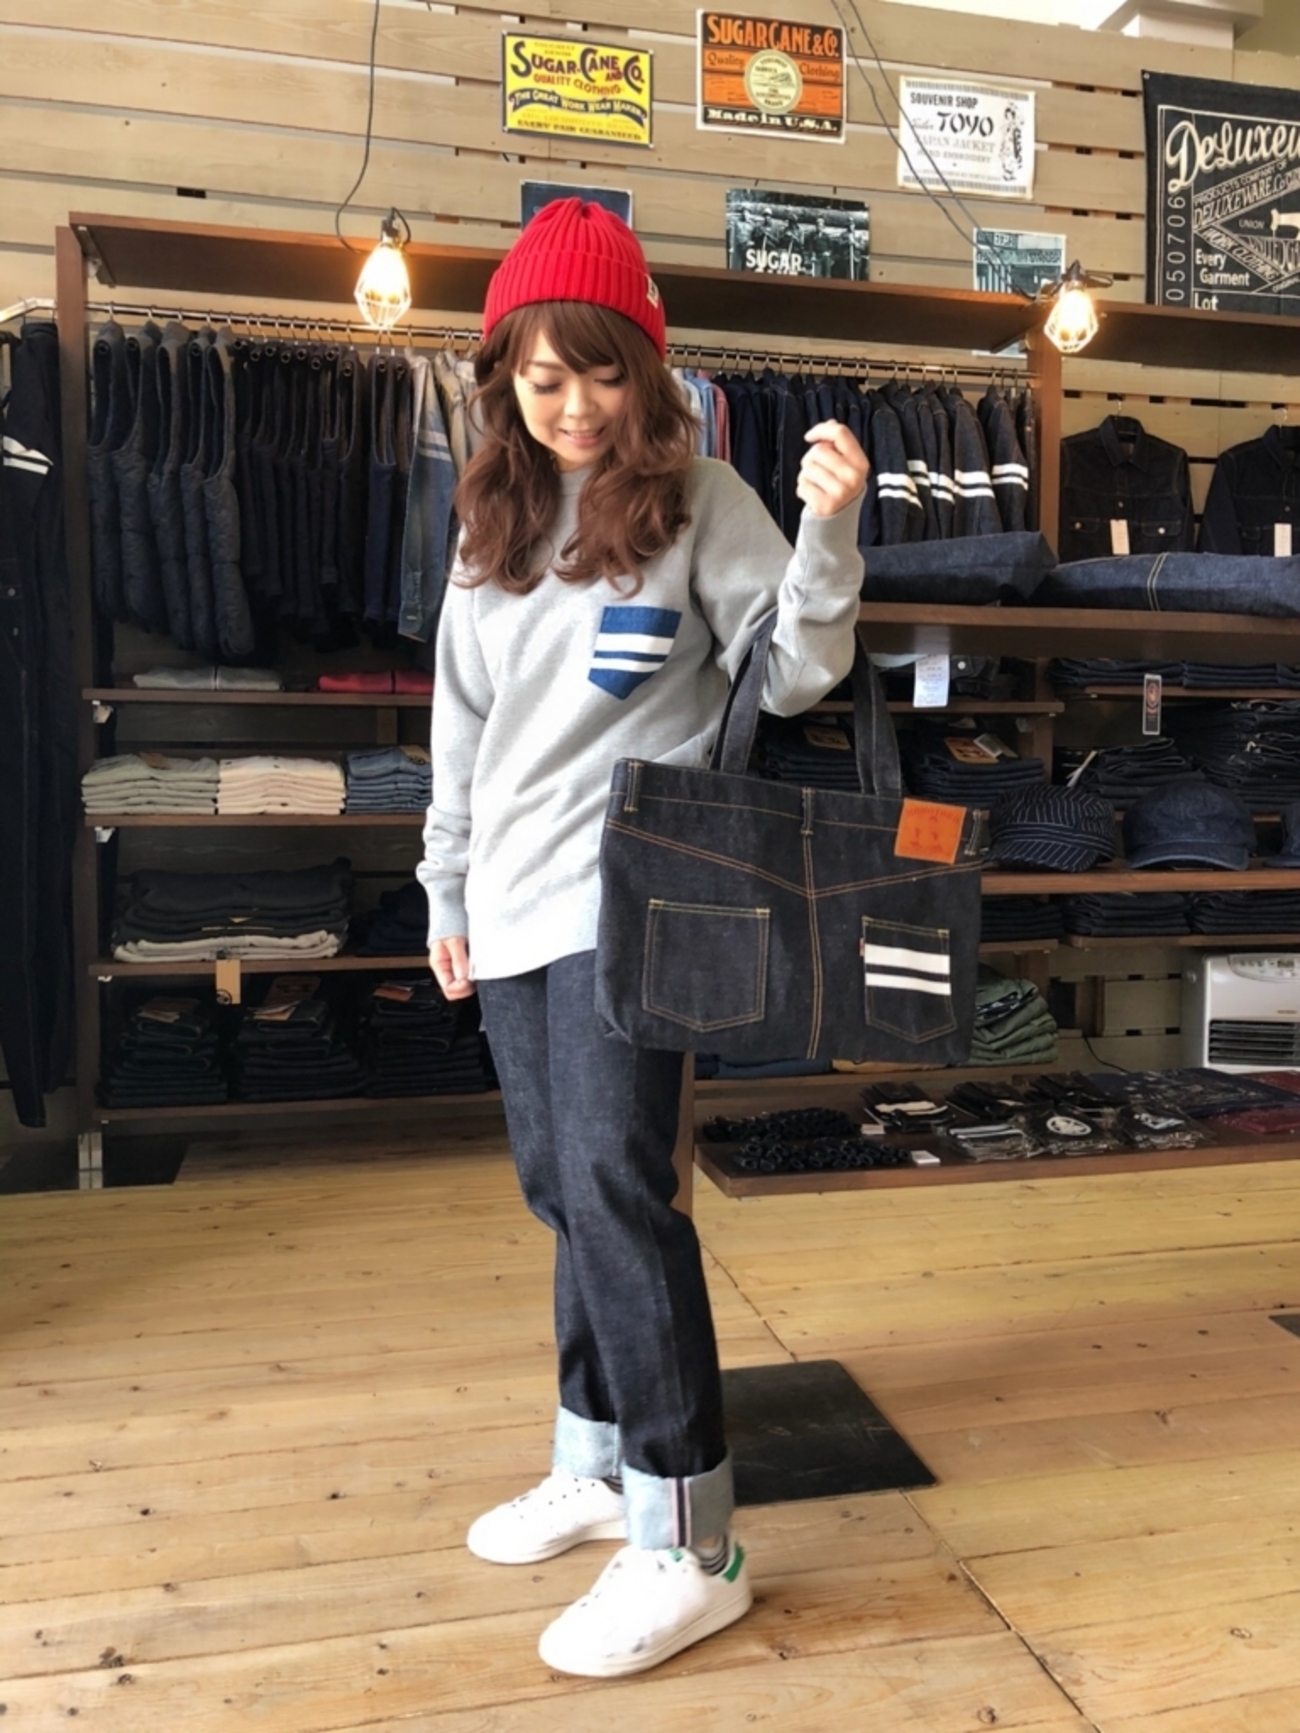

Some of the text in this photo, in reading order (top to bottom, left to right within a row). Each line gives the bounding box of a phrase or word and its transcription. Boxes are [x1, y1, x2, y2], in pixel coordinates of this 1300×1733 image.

[708, 51, 840, 82] Quality Clothing
[533, 73, 572, 86] QUALITY
[910, 92, 978, 109] SOUVENIR SHOP
[707, 109, 758, 122] Made
[784, 116, 838, 131] U.S.A.
[936, 111, 994, 137] TOYO
[1195, 248, 1226, 271] Every
[1199, 268, 1251, 287] Garment
[1194, 292, 1219, 311] Lot
